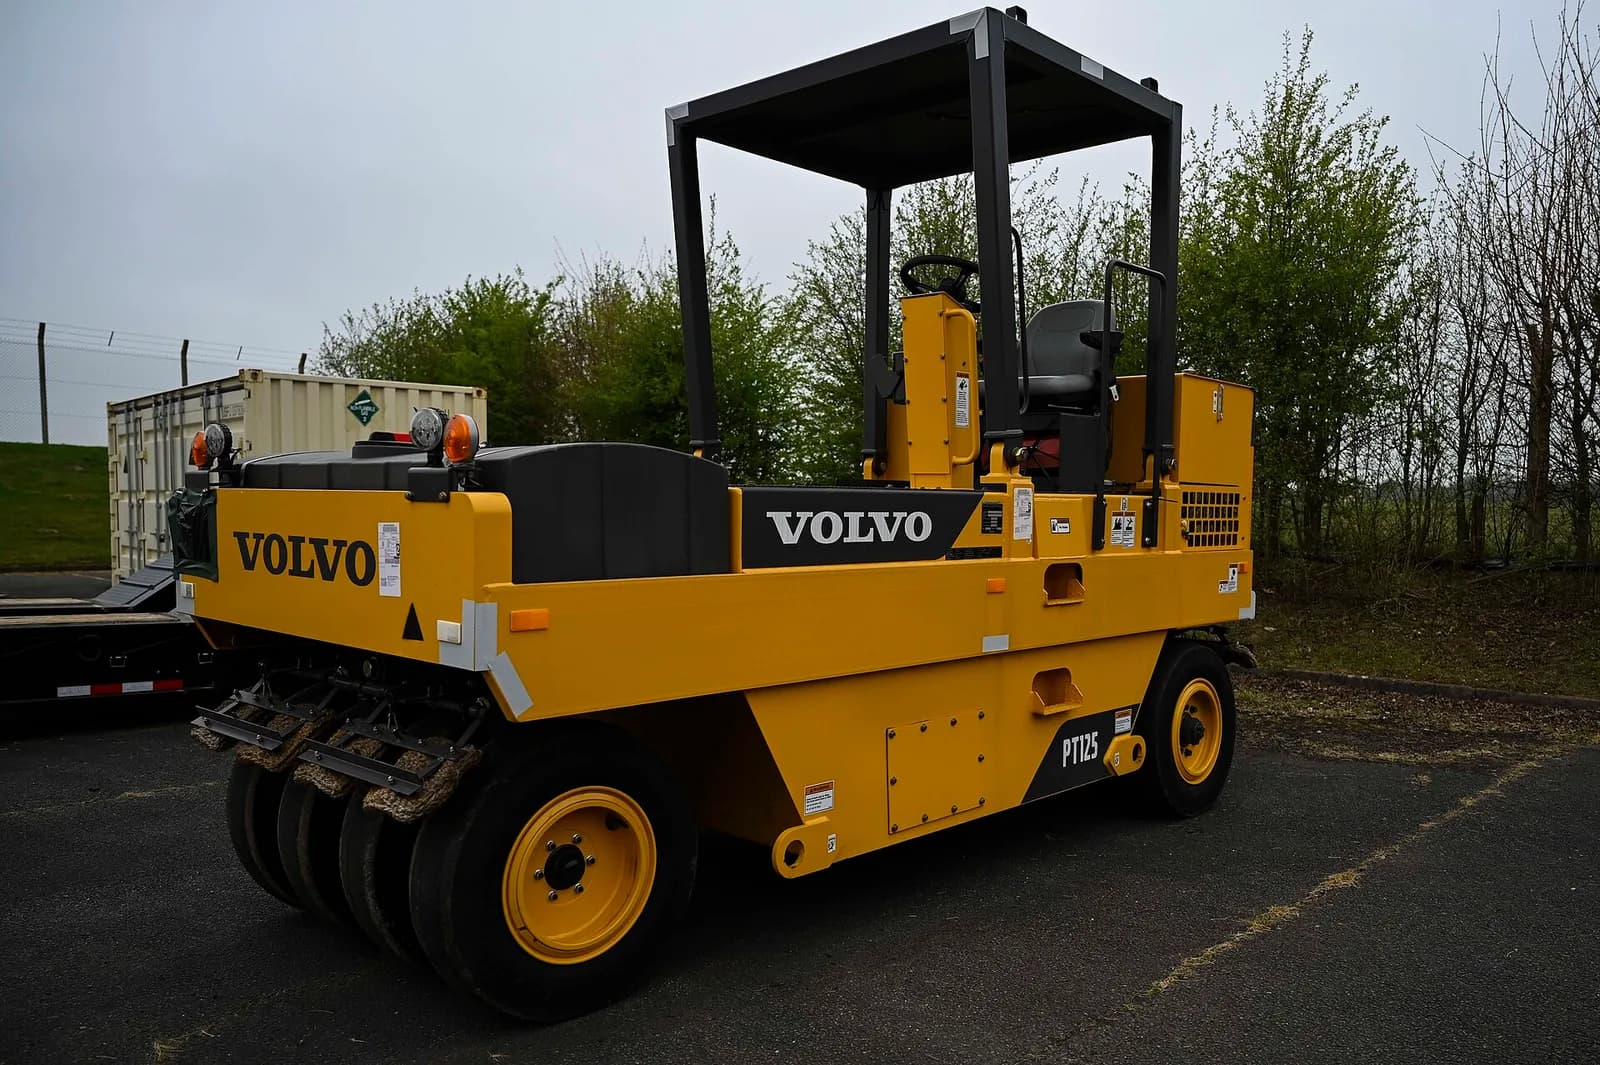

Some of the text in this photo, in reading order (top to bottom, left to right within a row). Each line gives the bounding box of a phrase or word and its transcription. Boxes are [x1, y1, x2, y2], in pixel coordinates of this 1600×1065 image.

[766, 511, 932, 544] VOLVO
[233, 531, 376, 587] VOLVO
[1062, 731, 1098, 767] PT125
